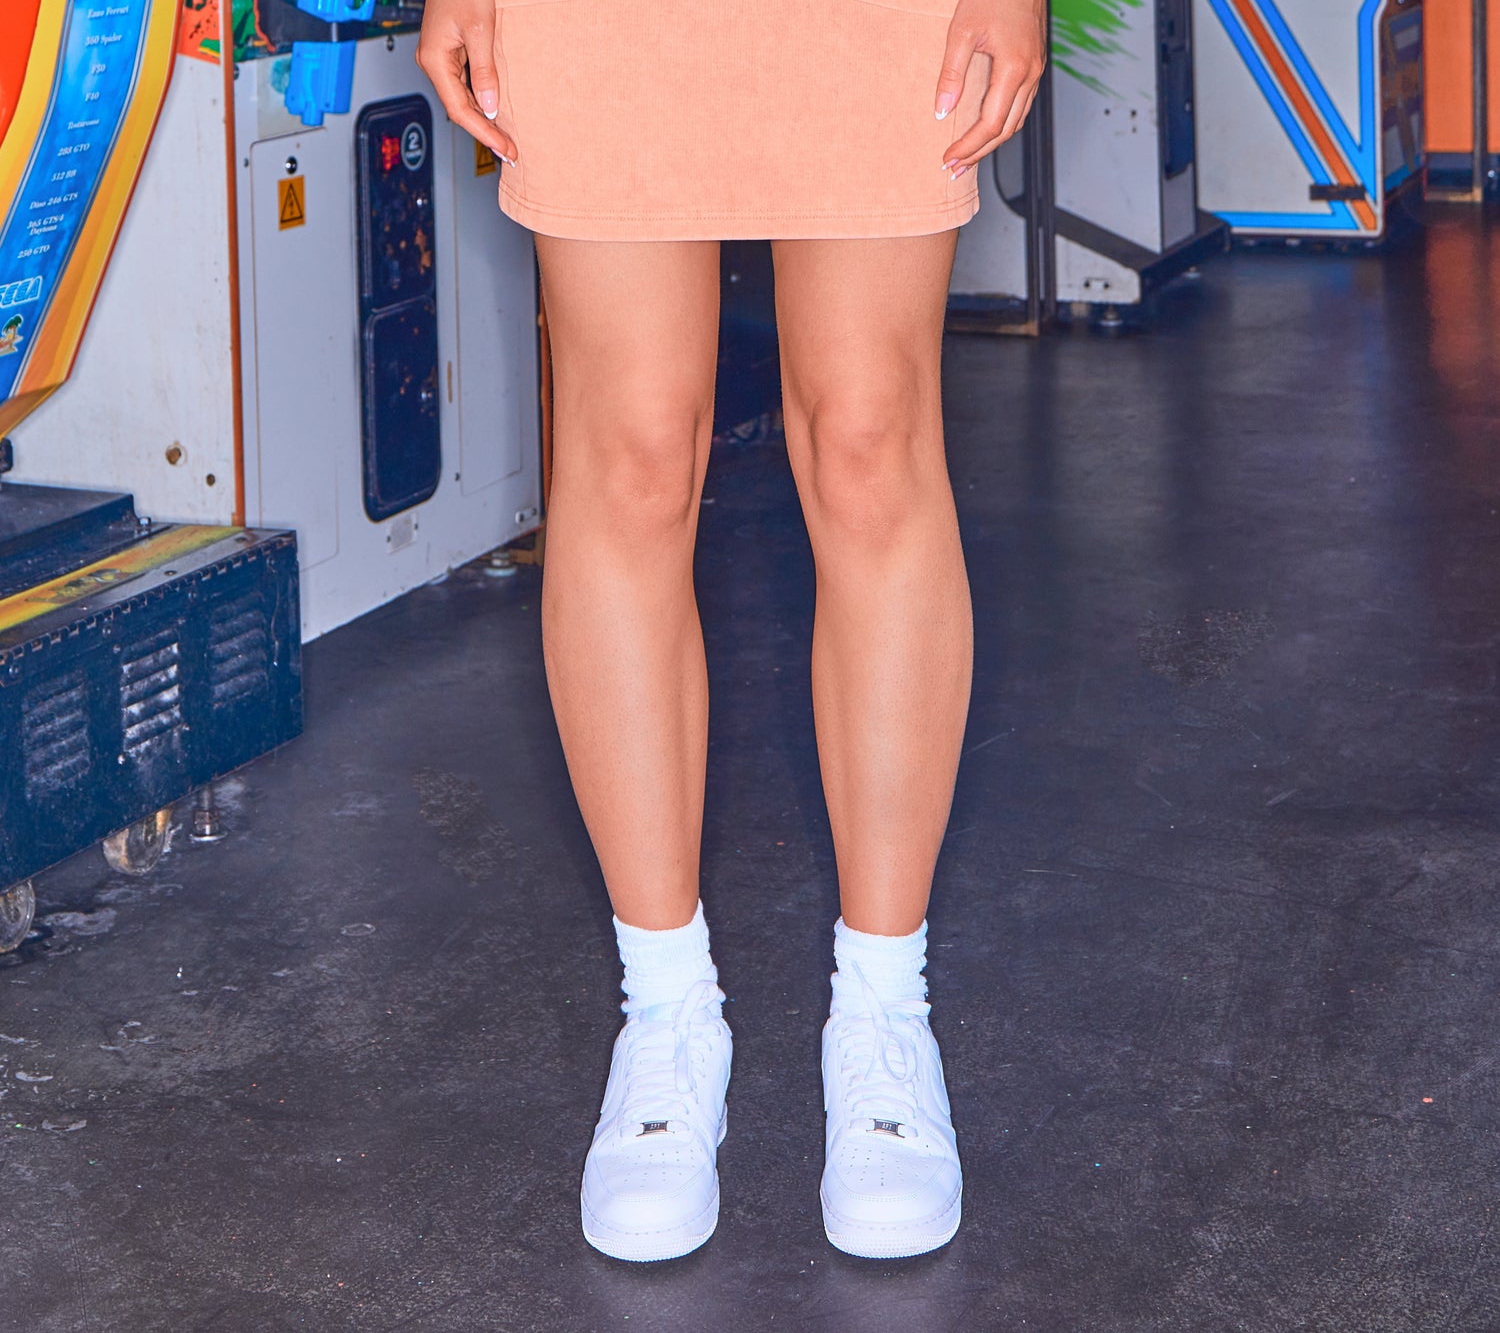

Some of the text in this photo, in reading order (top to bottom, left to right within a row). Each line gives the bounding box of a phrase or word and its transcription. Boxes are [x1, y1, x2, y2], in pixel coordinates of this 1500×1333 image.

[87, 5, 129, 19] Enzo Ferrari
[85, 33, 122, 46] 360 Spider
[91, 64, 106, 75] F50
[85, 91, 99, 102] F40
[408, 132, 419, 150] 2
[73, 143, 91, 153] GTO
[51, 171, 66, 182] 512
[29, 201, 46, 210] Dino
[63, 192, 79, 202] GTS
[33, 245, 51, 255] GTO
